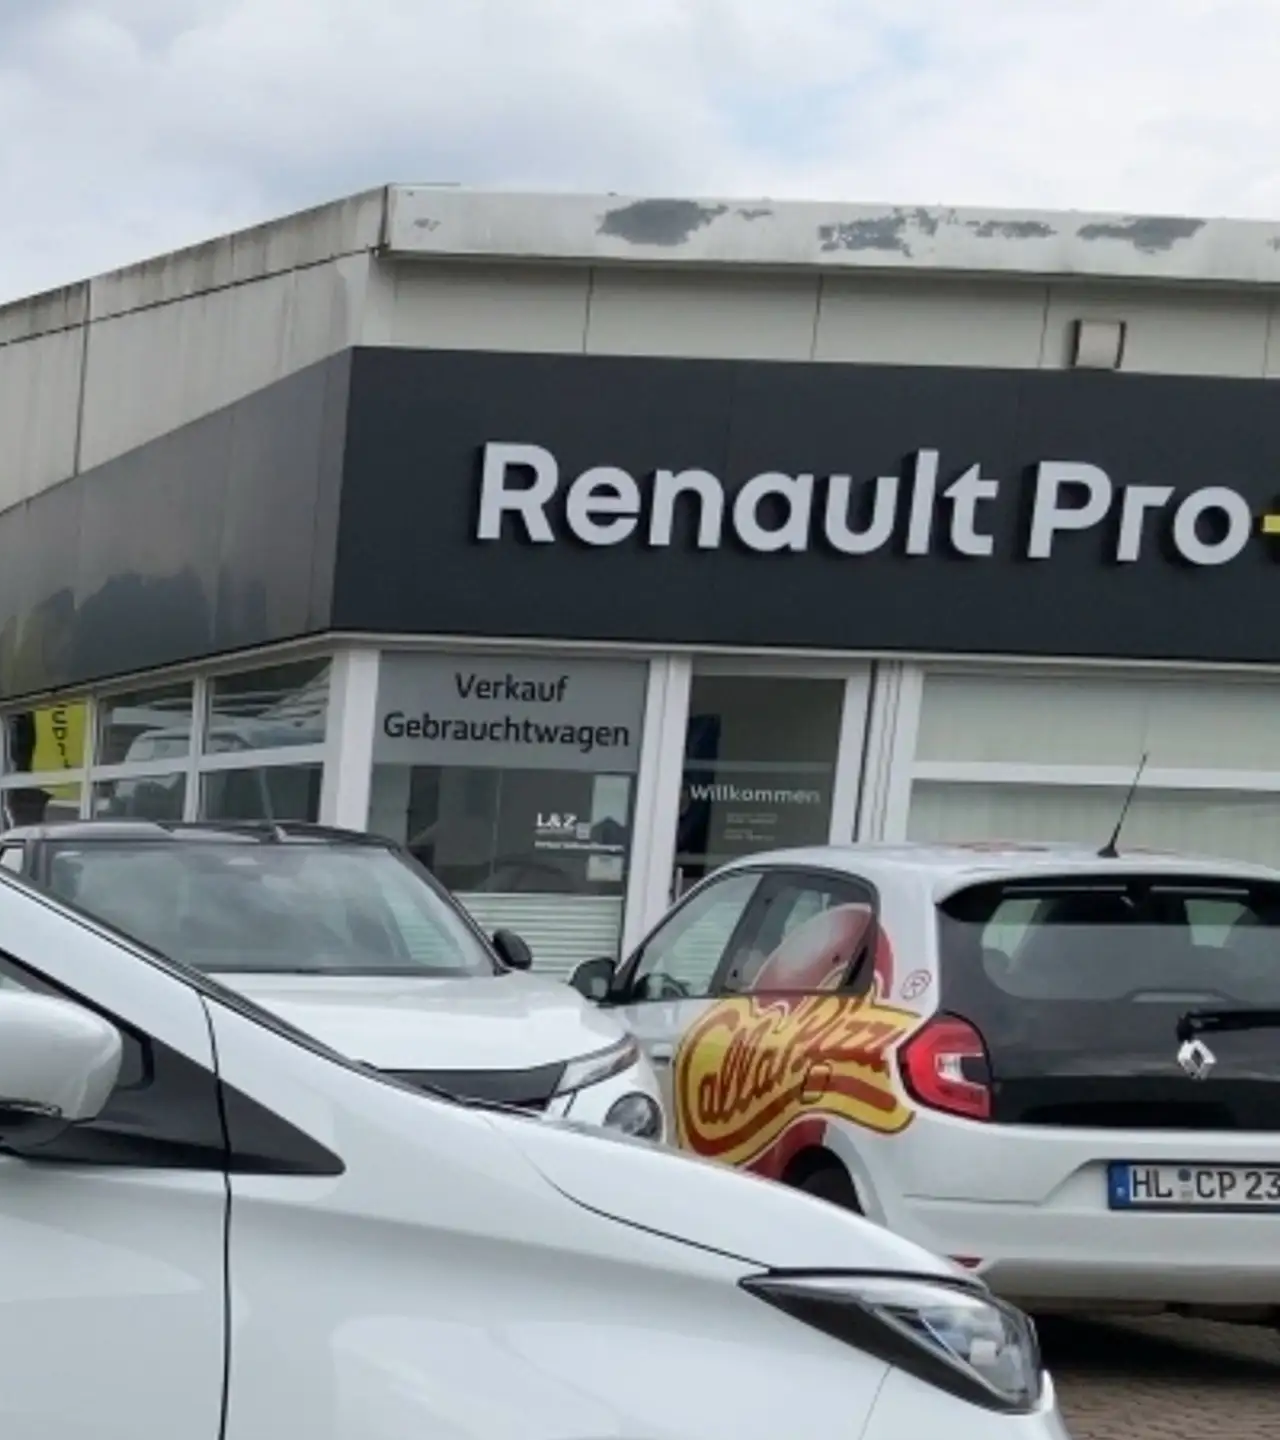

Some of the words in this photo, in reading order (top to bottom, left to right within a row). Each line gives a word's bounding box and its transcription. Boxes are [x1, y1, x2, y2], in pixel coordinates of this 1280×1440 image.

[477, 442, 998, 556] Renault
[454, 672, 569, 702] Verkauf
[383, 711, 630, 753] Gebrauchtwagen
[690, 783, 821, 805] Willkommen
[1132, 1168, 1173, 1198] HL
[1195, 1170, 1237, 1199] CP
[1244, 1171, 1280, 1200] 23
